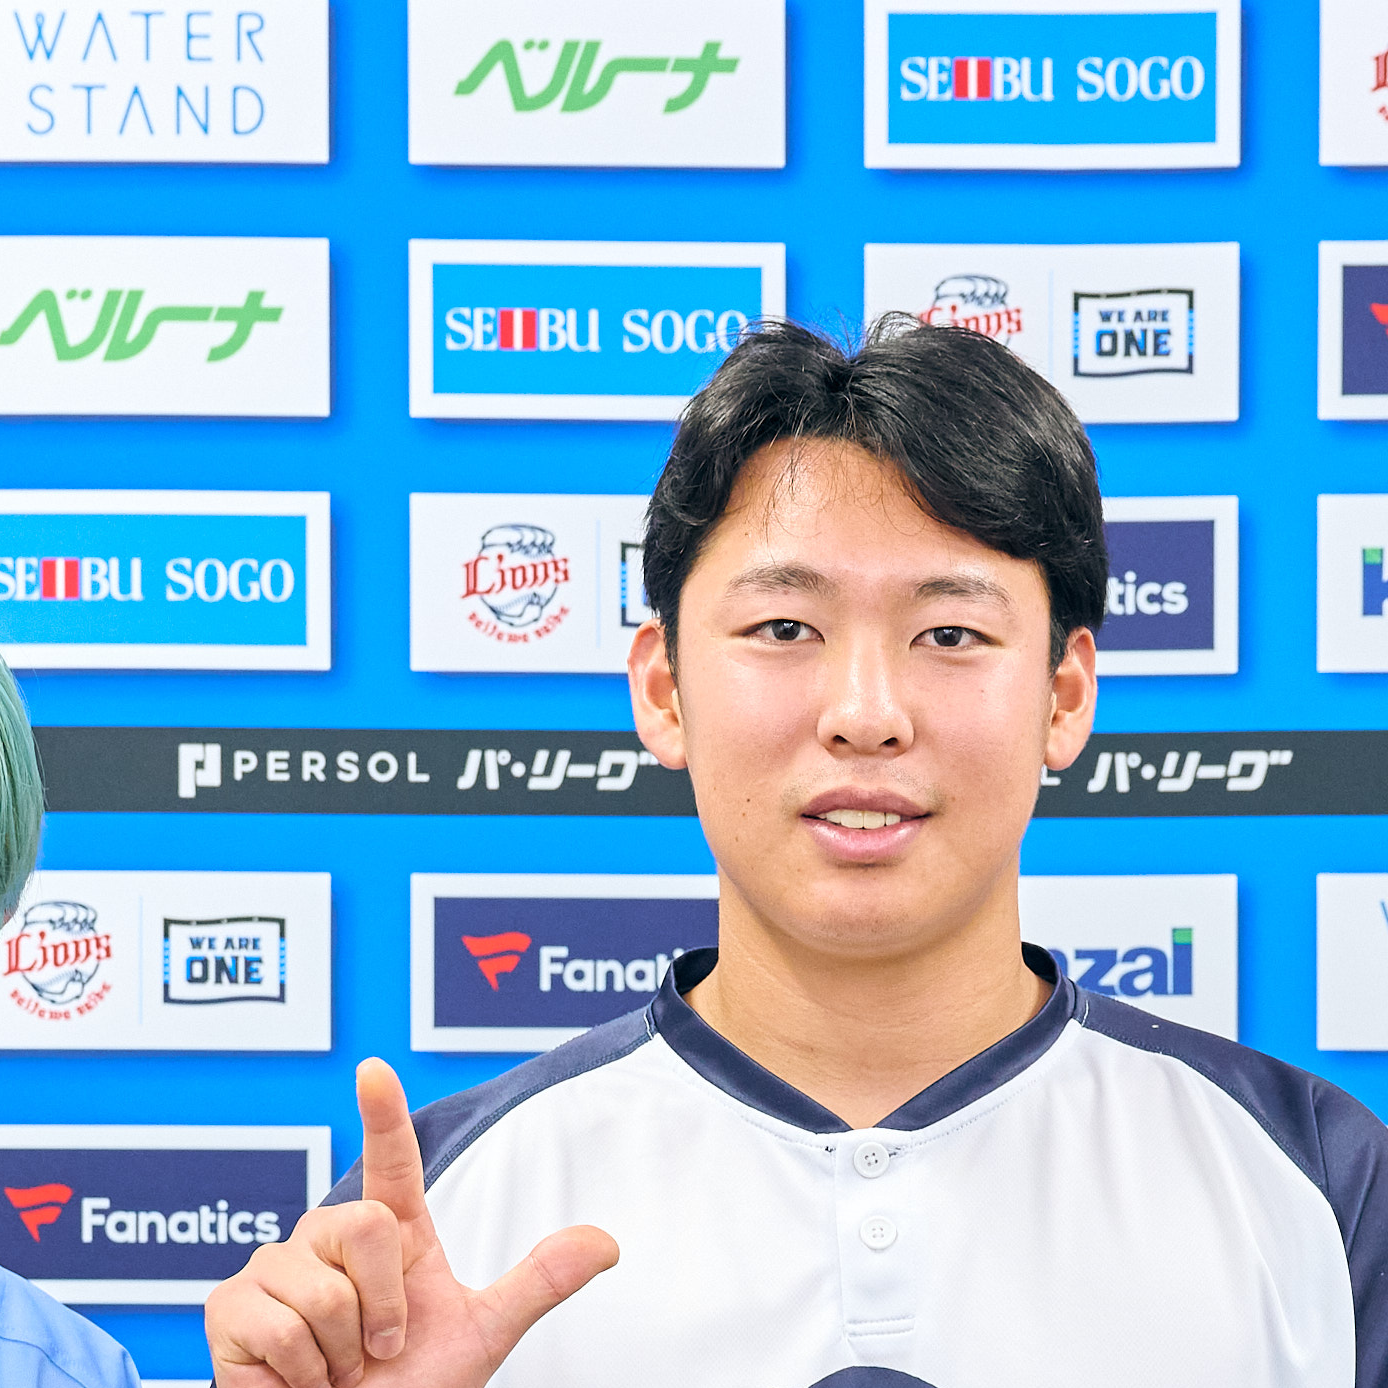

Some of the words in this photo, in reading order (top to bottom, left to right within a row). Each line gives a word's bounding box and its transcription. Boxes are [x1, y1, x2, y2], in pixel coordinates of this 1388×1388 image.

[14, 11, 265, 63] WATER
[454, 39, 740, 114] ベルーナ
[901, 57, 1054, 101] SEIBU
[1077, 56, 1205, 101] SOGO
[27, 84, 265, 136] STAND
[446, 308, 600, 352] SEIBU
[622, 308, 750, 354] SOGO
[1099, 310, 1125, 323] WE
[1133, 310, 1169, 322] ARE
[1096, 329, 1171, 357] ONE
[166, 558, 294, 602] SOGO
[462, 556, 572, 602] Lions
[1106, 569, 1189, 616] tics
[234, 750, 430, 782] PERSOL
[3, 929, 112, 975] Lions
[189, 937, 216, 950] WE
[224, 937, 260, 950] ARE
[186, 956, 263, 984] ONE
[539, 946, 678, 992] Fanat
[81, 1199, 281, 1245] Fanatics
